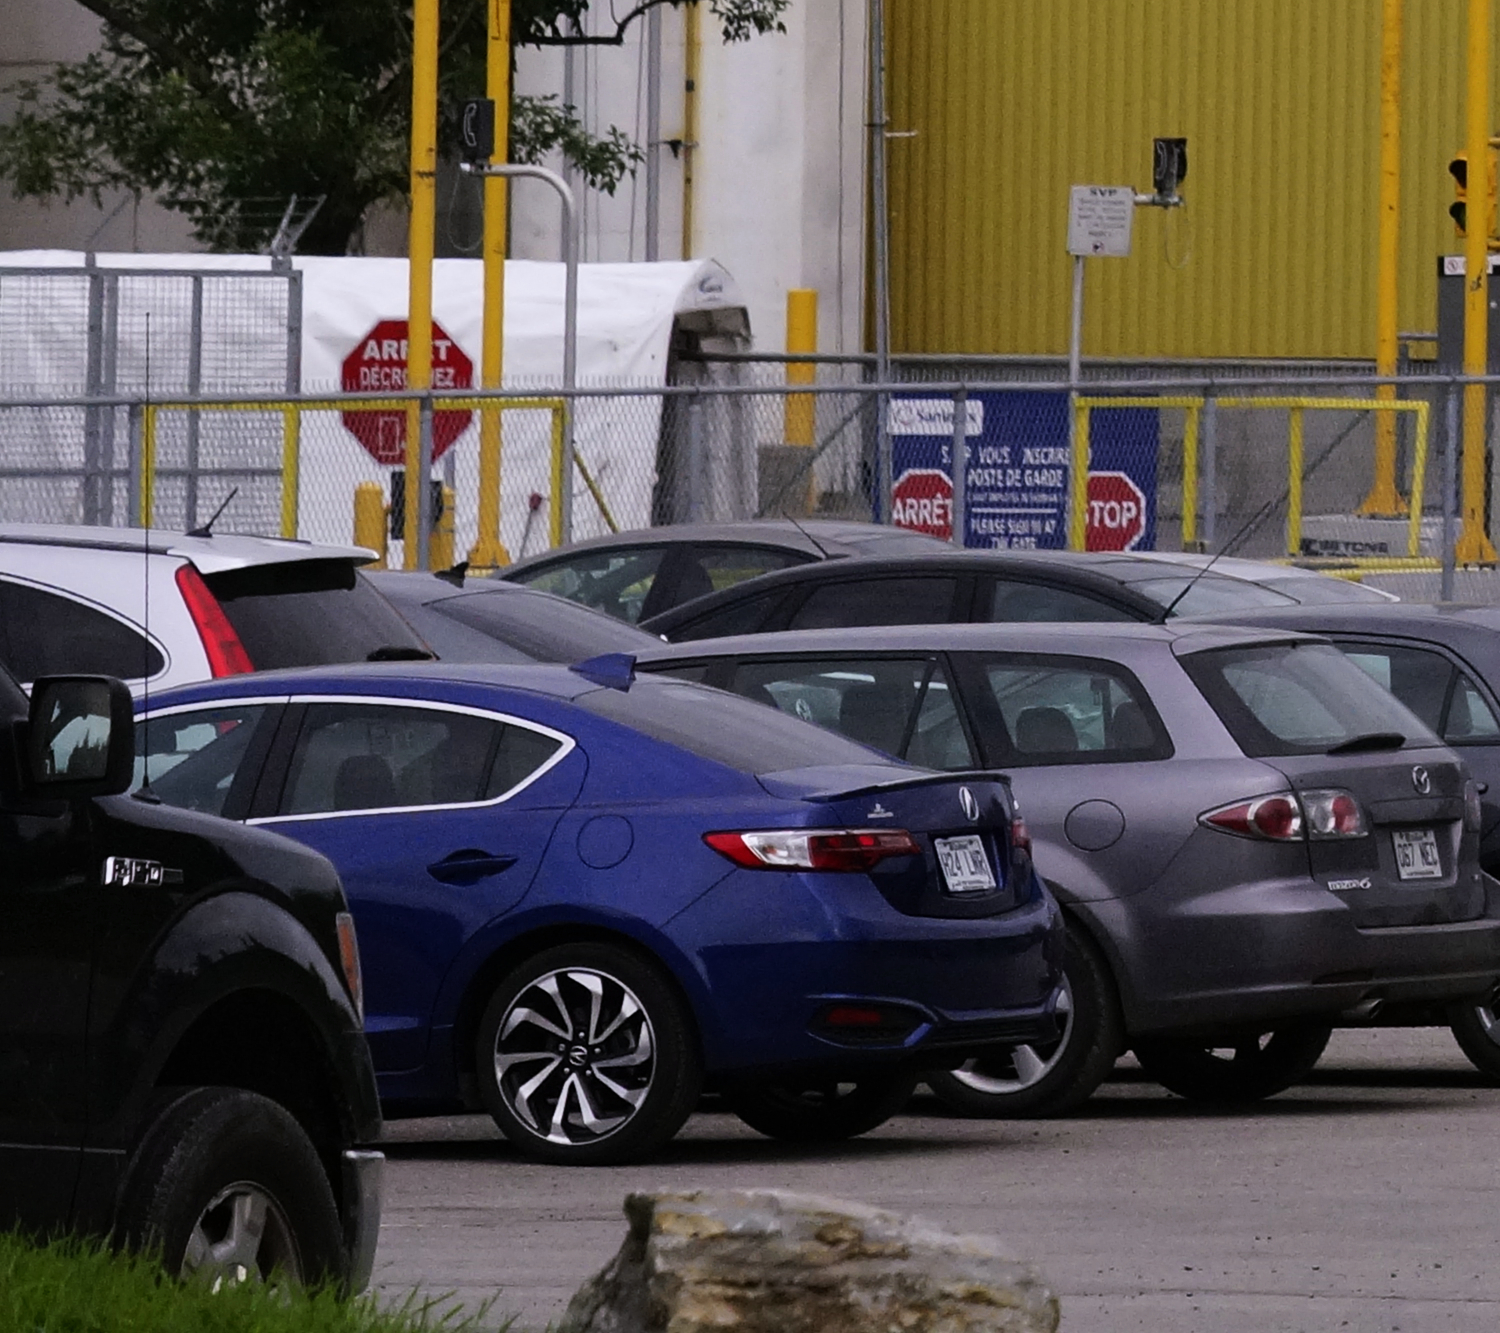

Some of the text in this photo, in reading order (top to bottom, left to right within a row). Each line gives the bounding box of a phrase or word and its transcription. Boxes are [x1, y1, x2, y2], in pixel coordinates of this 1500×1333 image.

[967, 469, 1063, 488] POSTE DE GARDE
[1085, 500, 1137, 529] TOP
